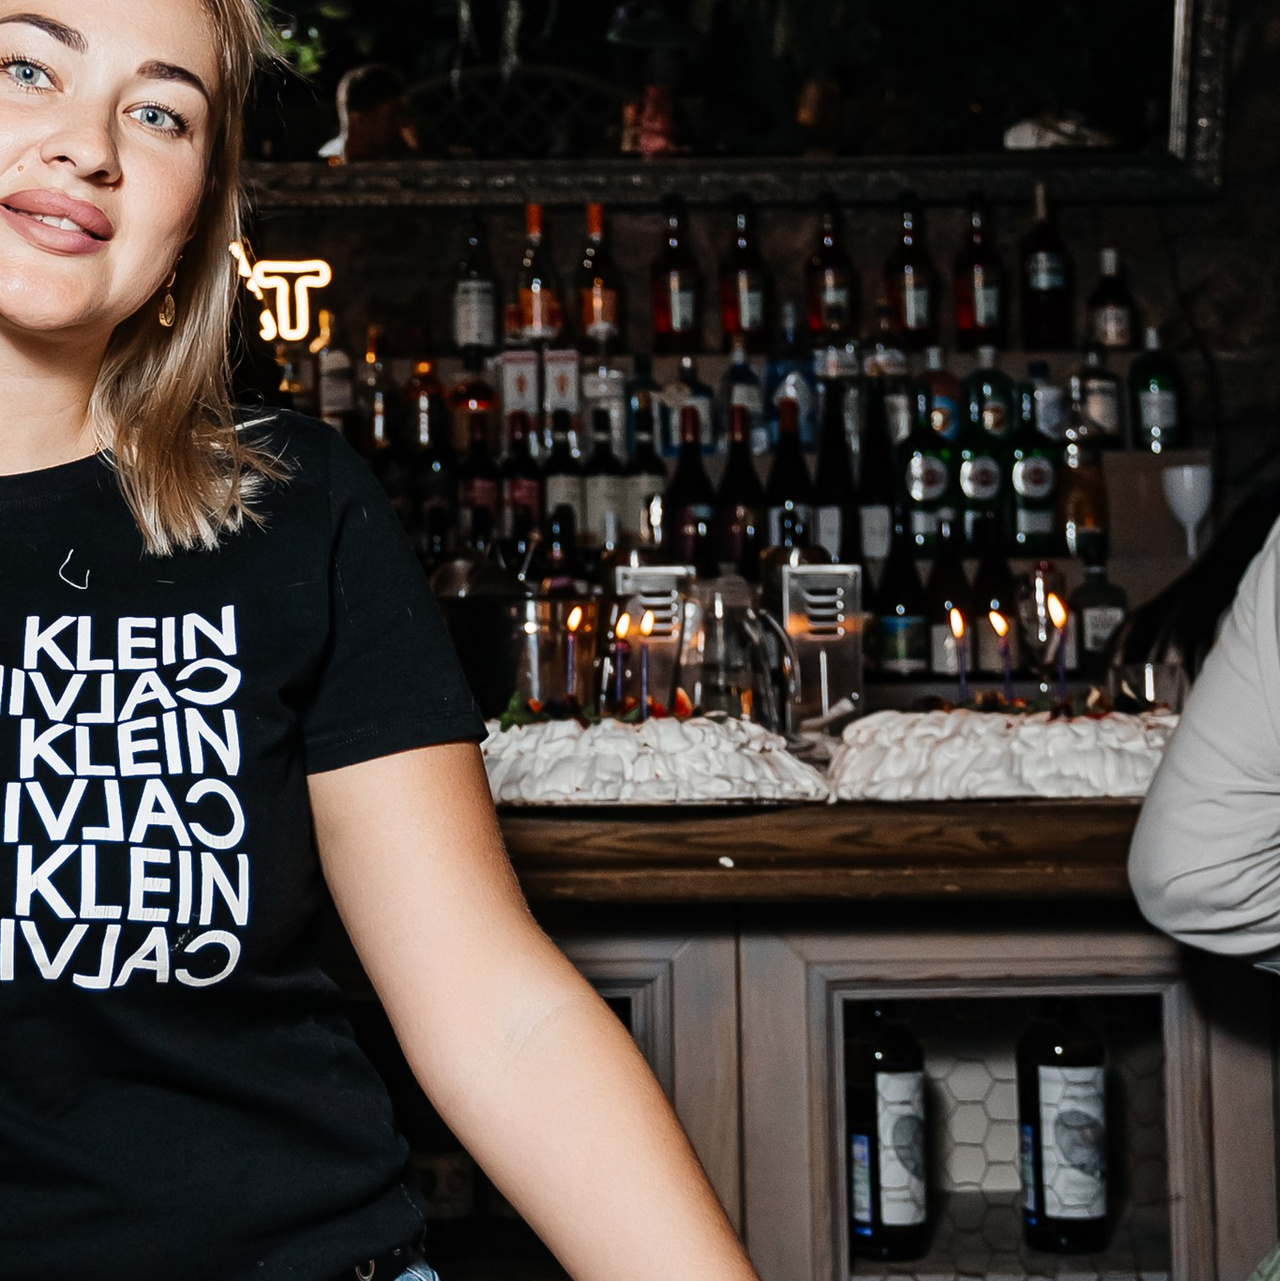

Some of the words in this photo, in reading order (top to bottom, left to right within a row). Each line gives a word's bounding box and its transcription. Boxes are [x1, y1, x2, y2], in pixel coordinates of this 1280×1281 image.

[24, 605, 237, 671] KLEIN
[20, 708, 240, 779] KLEIN
[15, 845, 249, 925] KLEIN
